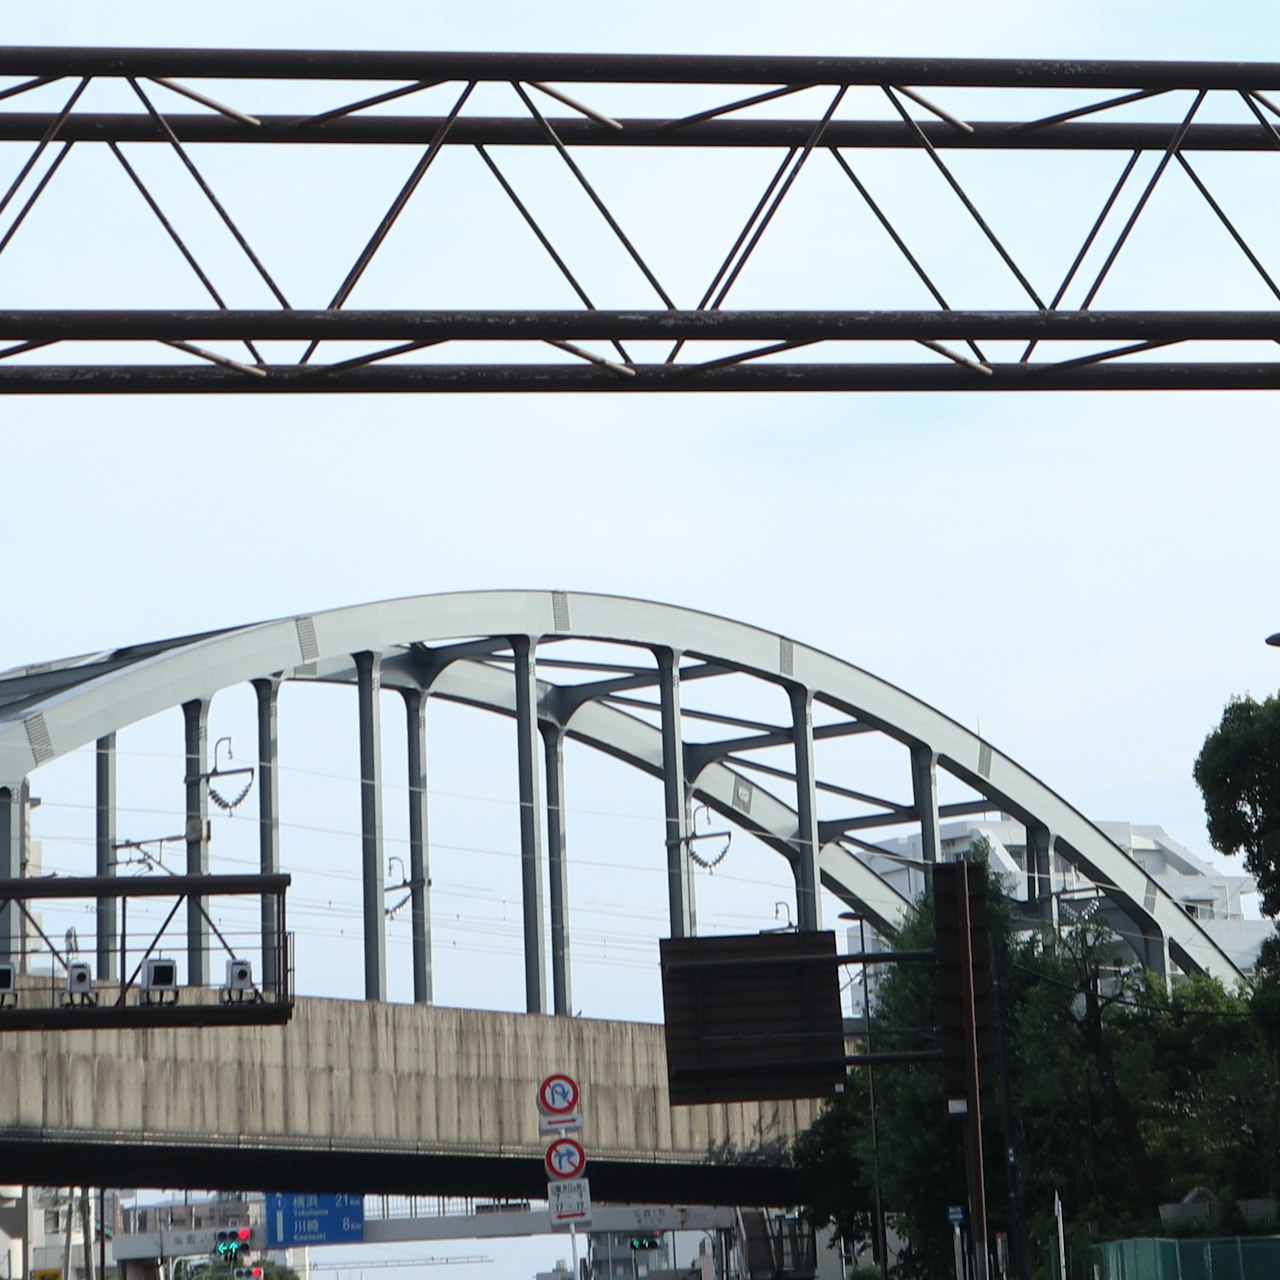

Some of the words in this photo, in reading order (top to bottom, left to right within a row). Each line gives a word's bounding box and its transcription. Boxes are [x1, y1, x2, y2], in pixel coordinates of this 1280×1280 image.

[293, 1194, 318, 1208] 横浜
[294, 1219, 319, 1233] 川崎
[294, 1233, 326, 1241] Kawasaki
